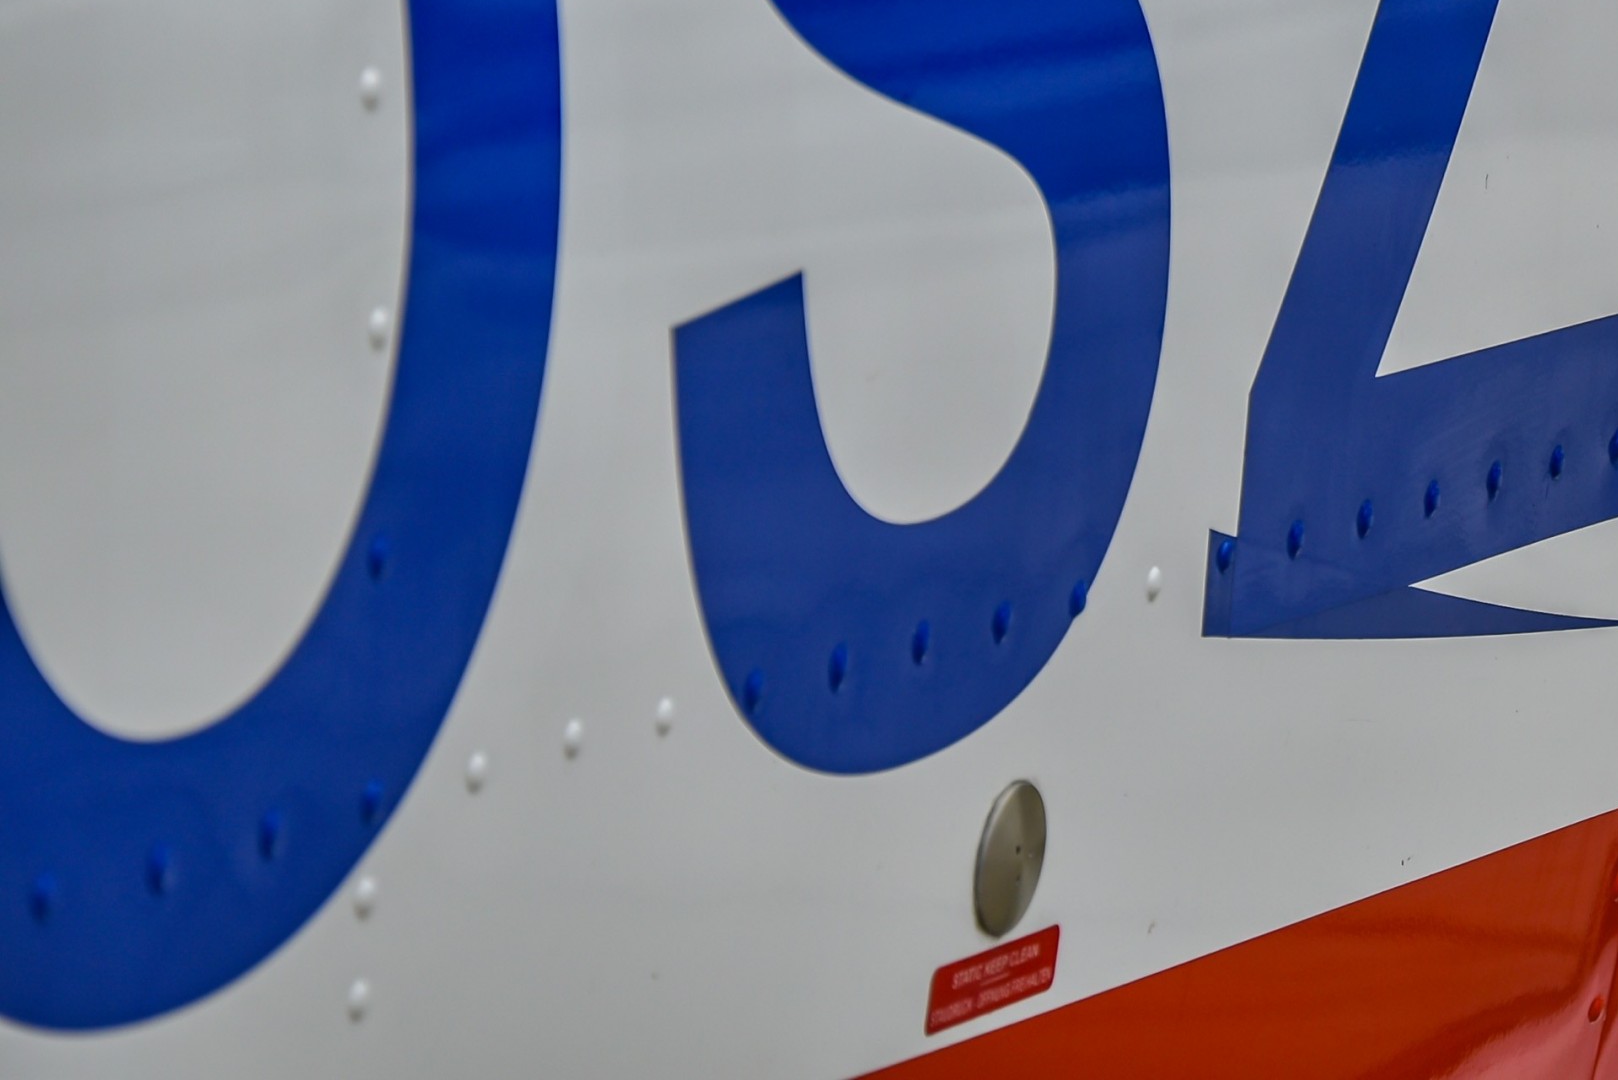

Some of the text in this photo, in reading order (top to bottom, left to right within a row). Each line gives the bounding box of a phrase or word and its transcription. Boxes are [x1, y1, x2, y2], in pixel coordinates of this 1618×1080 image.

[952, 944, 1040, 989] STATIC KEEP CLEAN
